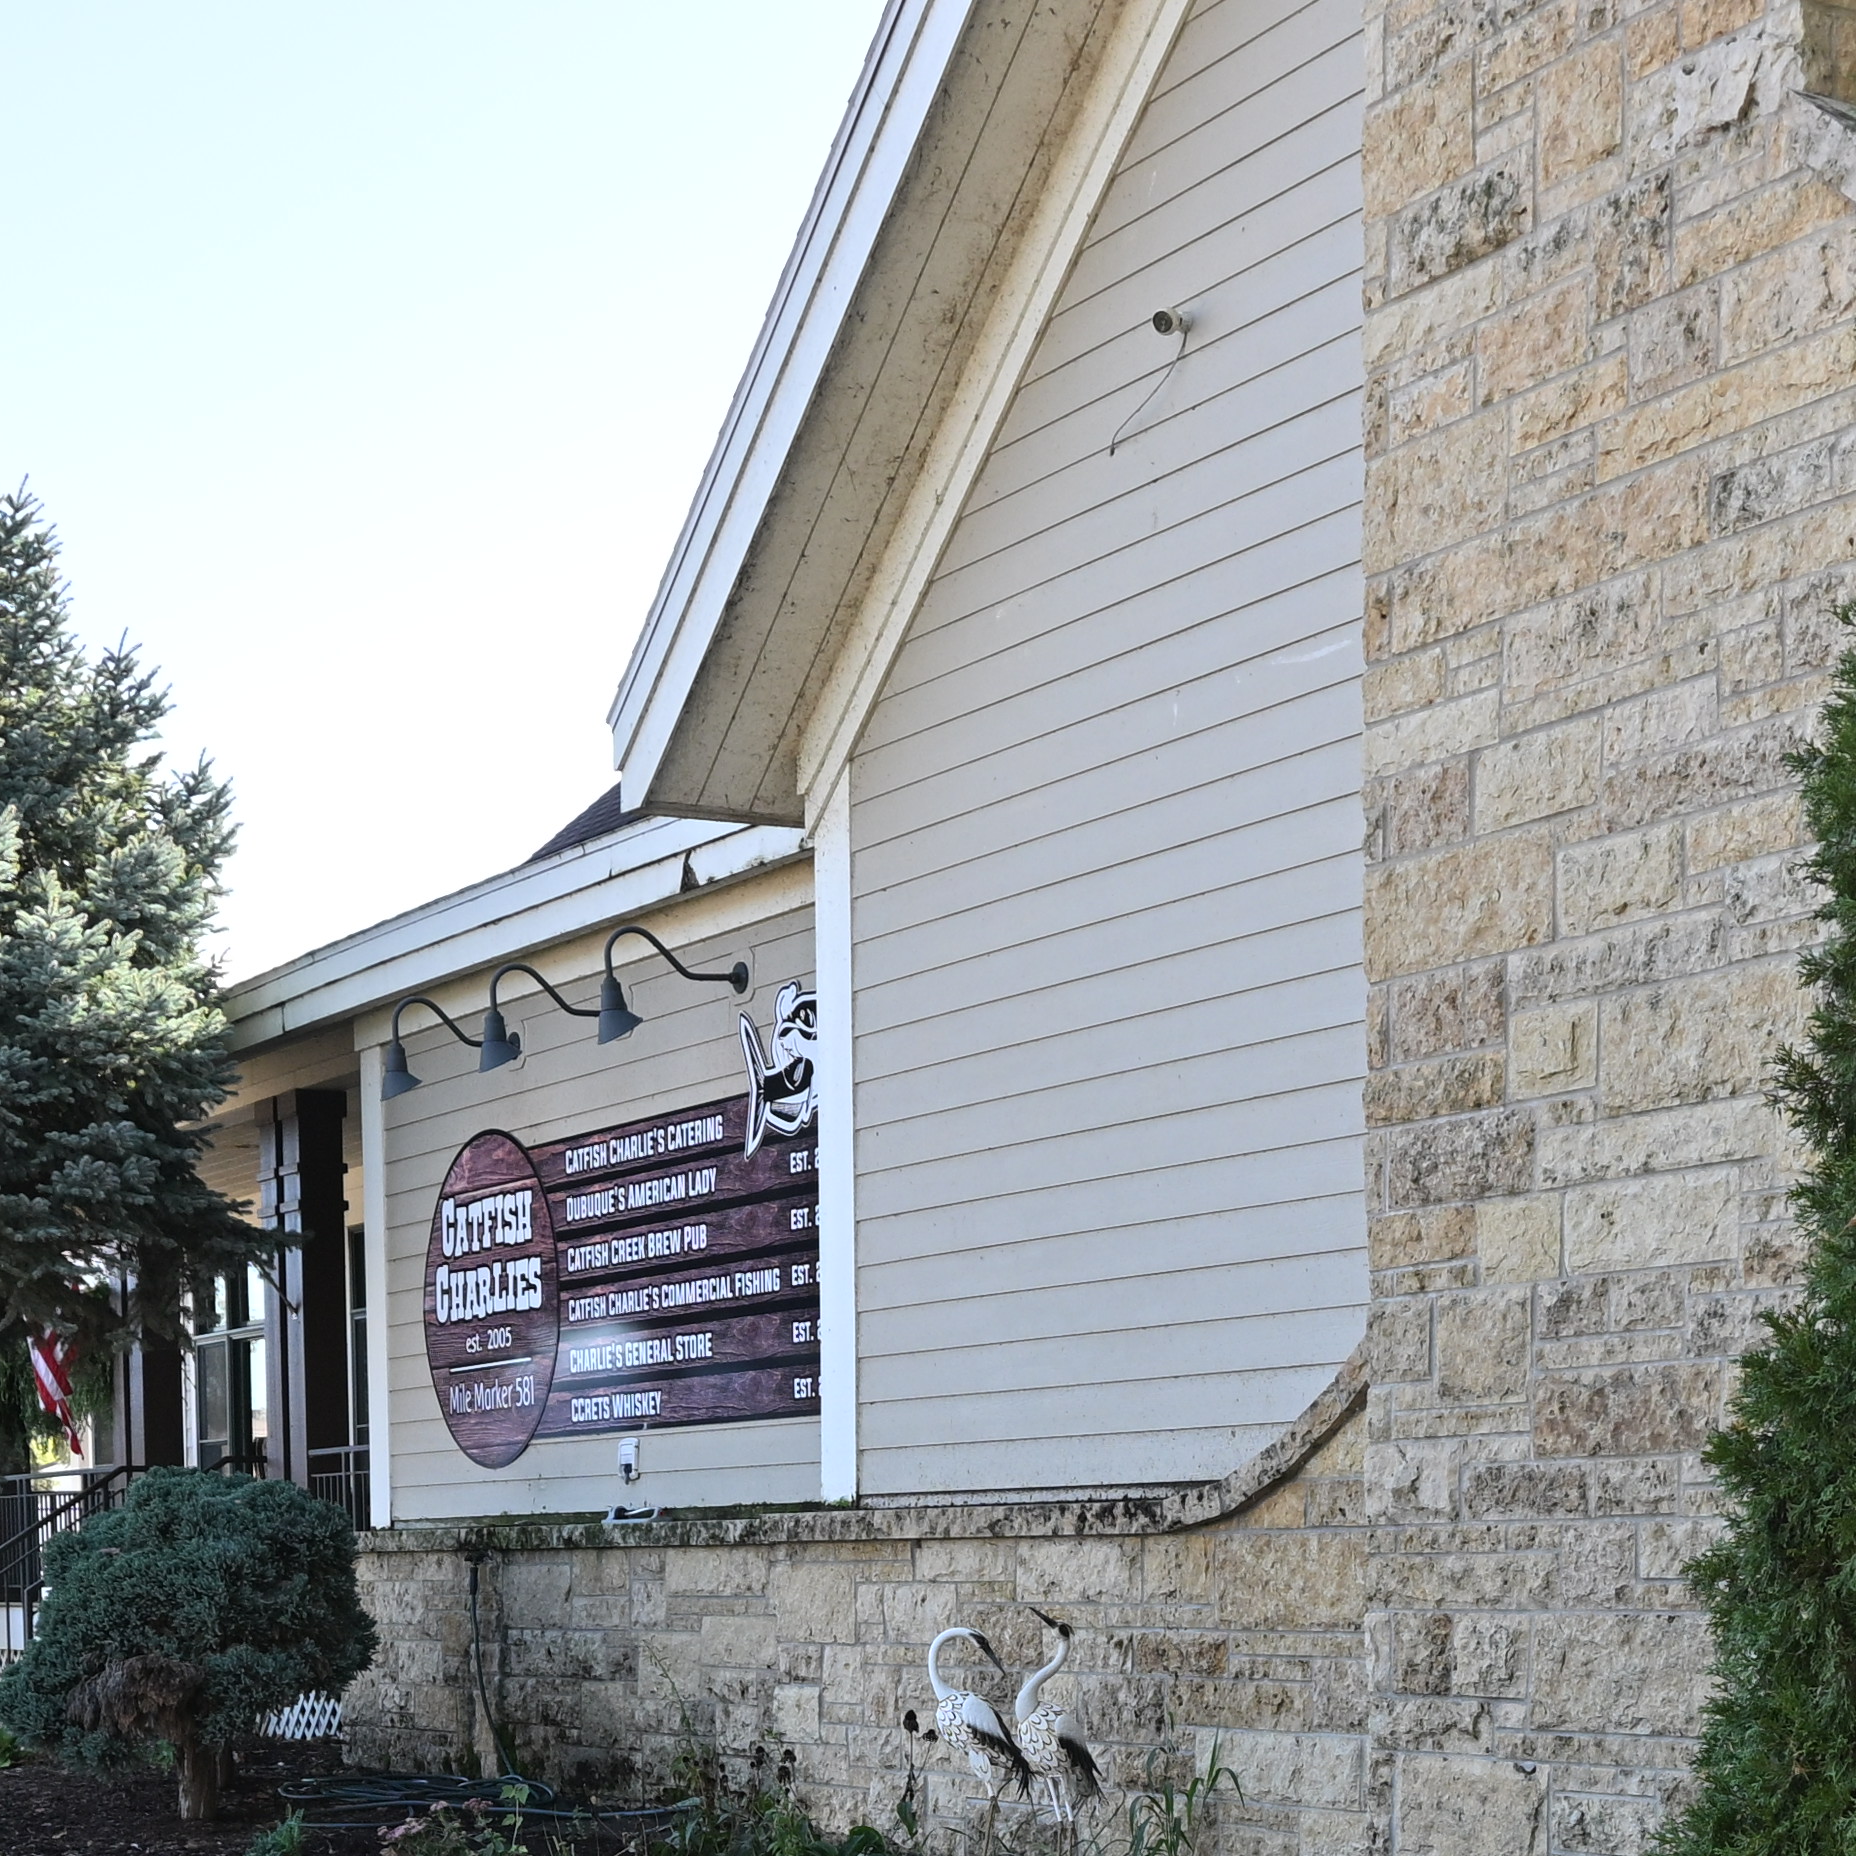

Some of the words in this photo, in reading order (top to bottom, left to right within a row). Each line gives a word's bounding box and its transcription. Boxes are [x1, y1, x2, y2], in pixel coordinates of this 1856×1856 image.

[566, 1142, 607, 1174] CATFISH
[609, 1128, 665, 1164] CHARLIE'S
[668, 1114, 724, 1150] CATERING
[566, 1186, 626, 1222] DUBUQUE'S
[628, 1174, 686, 1209] AMERICAN
[688, 1167, 717, 1196] LADY
[790, 1150, 812, 1174] EST.
[442, 1190, 532, 1257] CATFISH
[567, 1242, 609, 1272] CATFISH
[611, 1236, 645, 1264] CREEK
[648, 1229, 681, 1258] BREW
[684, 1224, 707, 1252] PUB
[790, 1208, 812, 1230] EST.
[436, 1257, 542, 1323] CHARLIES
[568, 1296, 606, 1322] CATFISH
[608, 1285, 659, 1316] CHARLIE'S
[661, 1275, 733, 1307] COMMERCIAL
[735, 1268, 780, 1297] FISHING
[792, 1264, 813, 1286] EST.
[487, 1327, 512, 1349] 2005
[570, 1343, 623, 1373] CHARLIE'S
[625, 1338, 674, 1367] GENERAL
[676, 1332, 712, 1361] STORE
[792, 1321, 814, 1343] EST.
[450, 1383, 472, 1414] Mile
[474, 1379, 513, 1411] Marker
[516, 1375, 534, 1406] 581
[571, 1396, 610, 1422] CCRETS
[611, 1391, 662, 1418] WHISKEY
[794, 1378, 816, 1399] EST.
